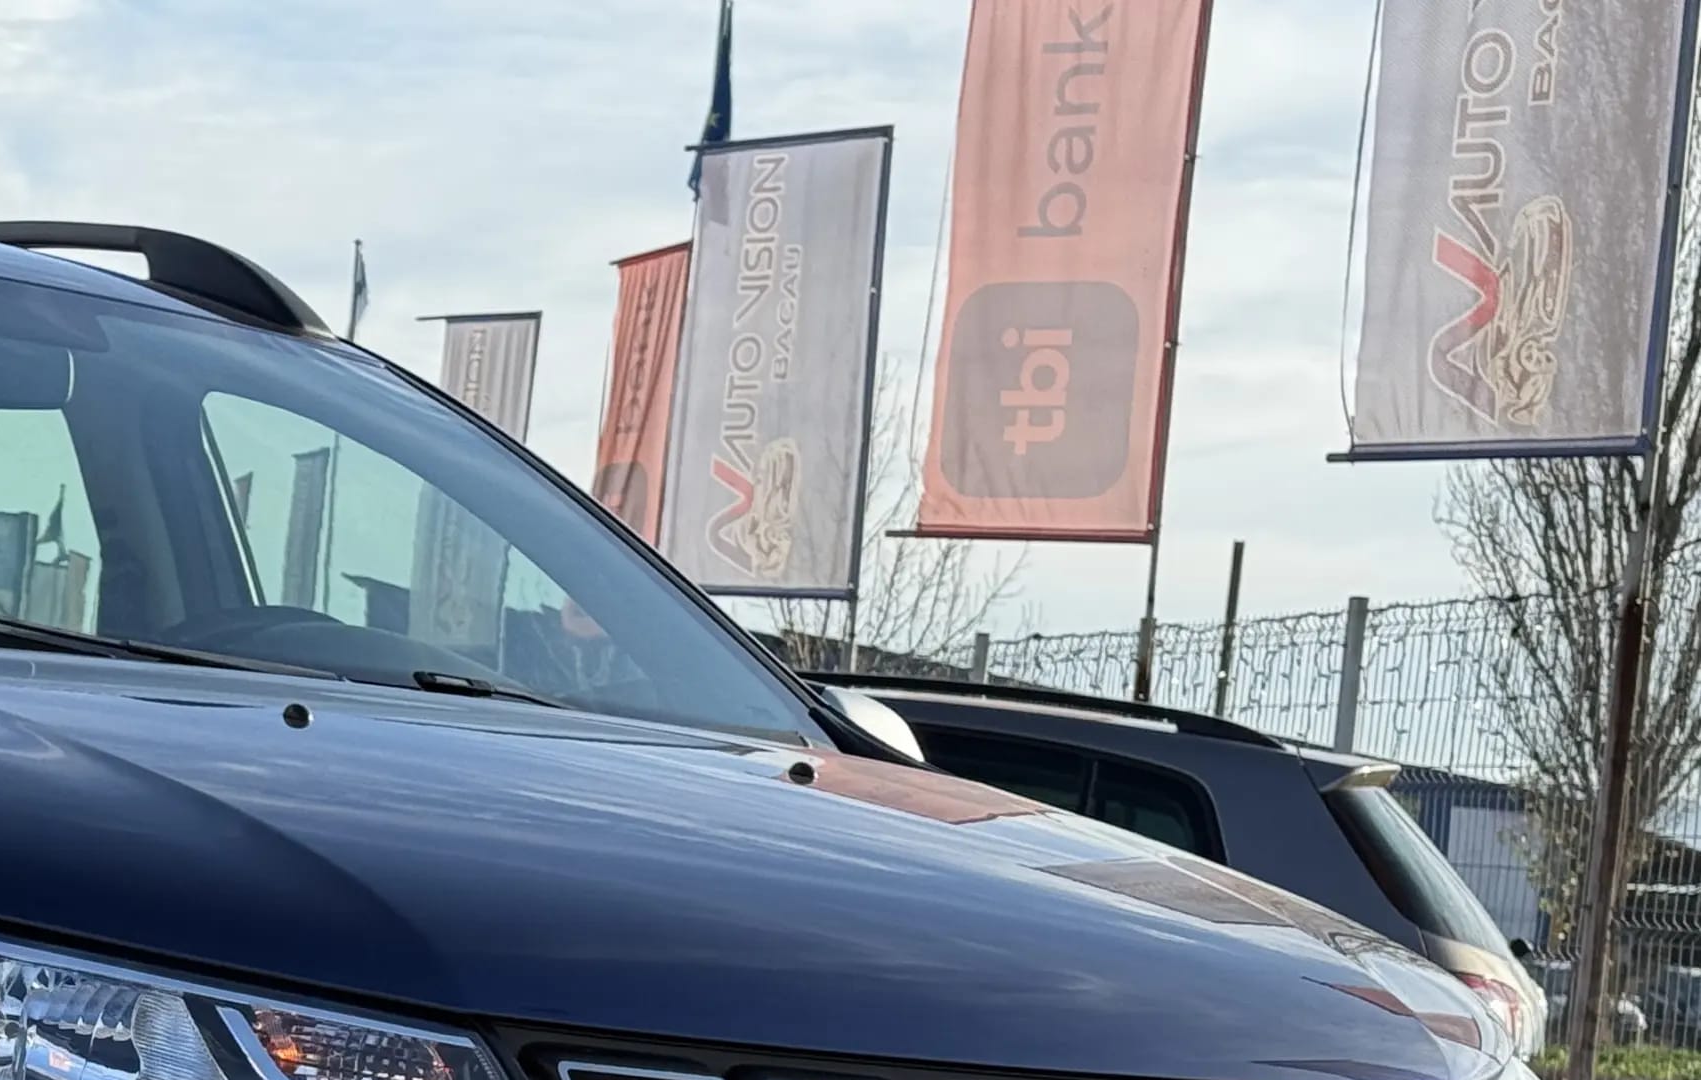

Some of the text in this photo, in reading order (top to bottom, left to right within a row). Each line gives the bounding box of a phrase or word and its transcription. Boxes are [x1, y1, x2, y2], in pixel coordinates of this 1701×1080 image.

[1000, 2, 1113, 456] tbi bank
[1448, 27, 1517, 258] AUTO
[719, 154, 787, 468] AUTO VISION
[772, 246, 801, 381] BACAU
